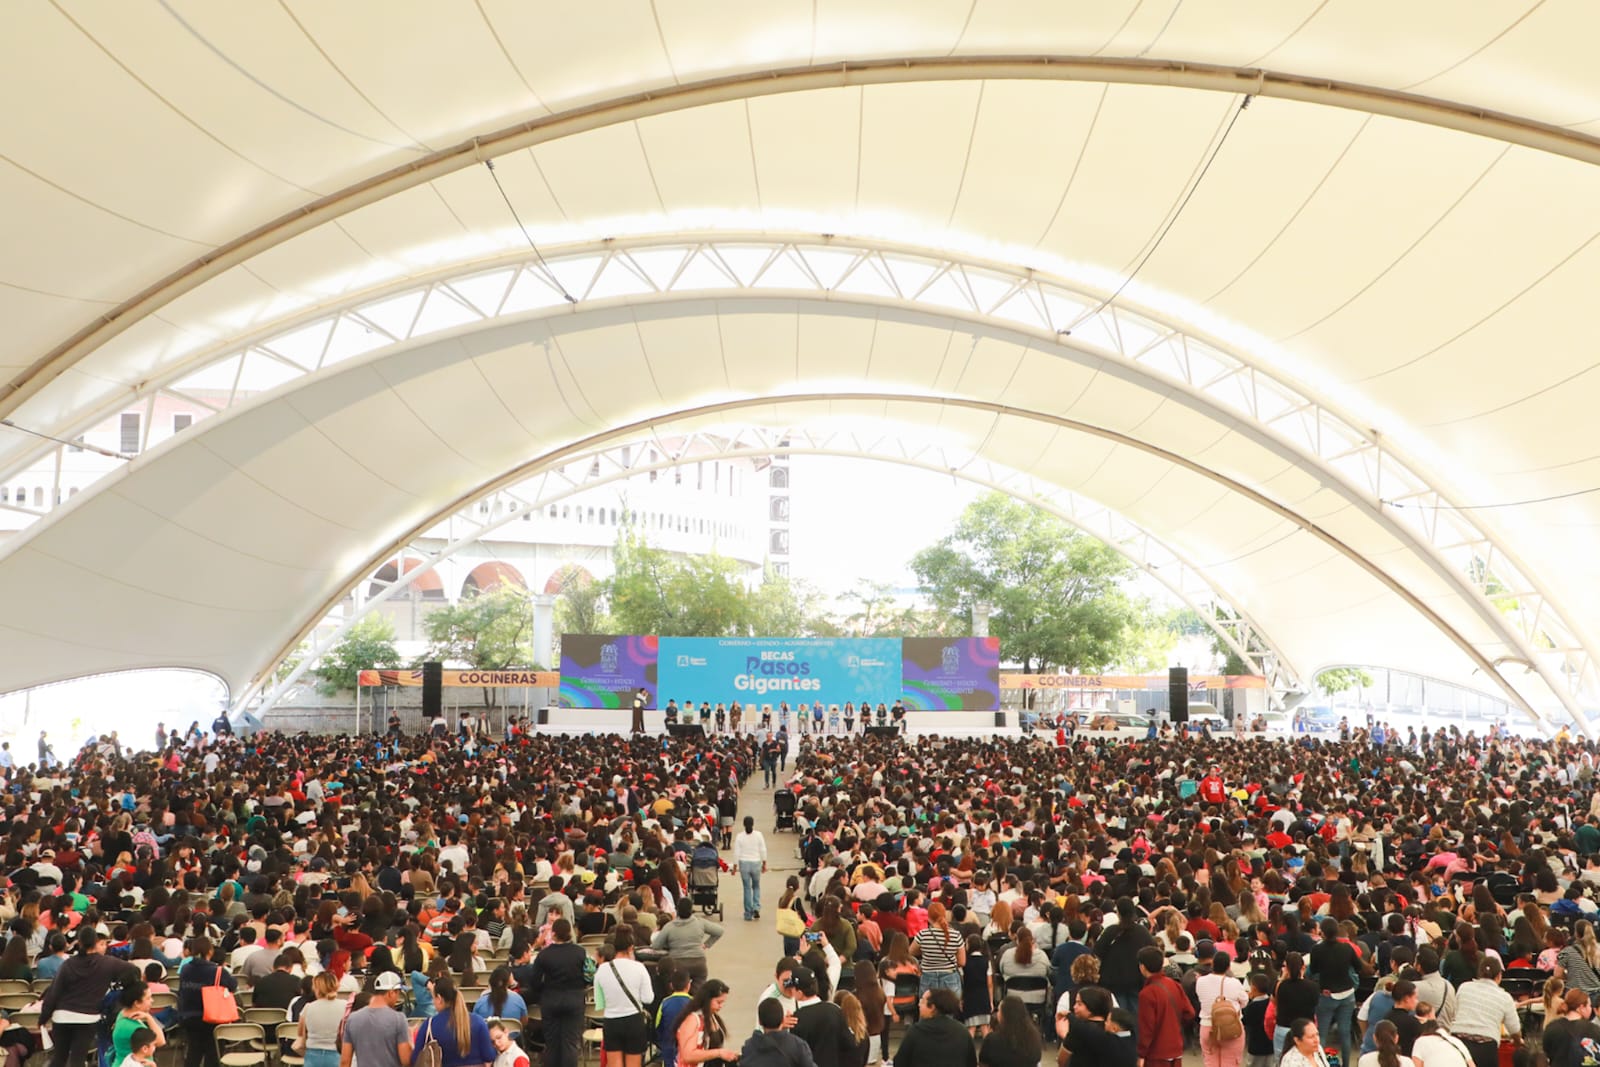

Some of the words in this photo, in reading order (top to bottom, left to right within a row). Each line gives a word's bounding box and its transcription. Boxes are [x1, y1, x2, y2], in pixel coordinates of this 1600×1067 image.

[761, 651, 795, 661] BECAS
[746, 656, 811, 676] Pasos
[459, 672, 537, 684] COCINERAS
[734, 674, 821, 694] Gigantes
[1038, 676, 1102, 687] COCINERAS
